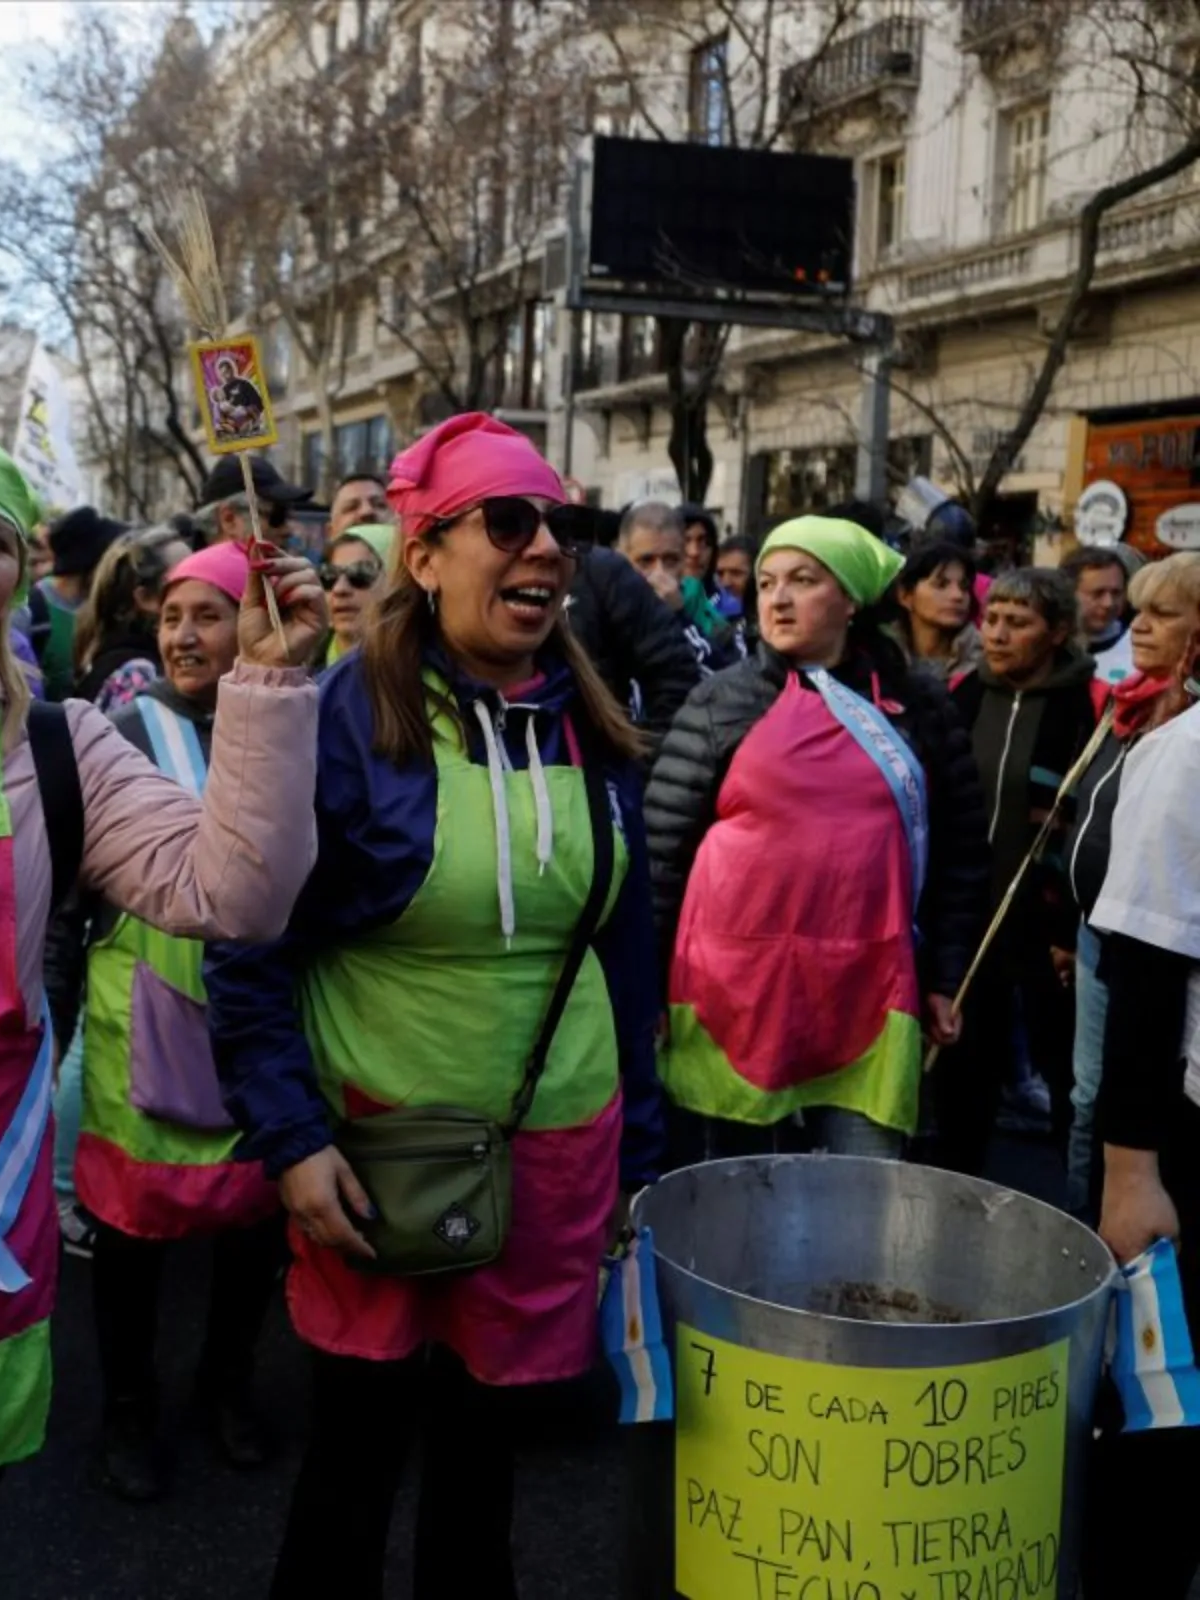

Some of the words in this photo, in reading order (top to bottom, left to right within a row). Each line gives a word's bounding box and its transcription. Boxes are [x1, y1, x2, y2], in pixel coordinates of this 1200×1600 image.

[690, 1341, 717, 1397] 7
[744, 1379, 785, 1414] DE
[807, 1392, 889, 1425] CADA
[914, 1378, 968, 1427] 10
[993, 1370, 1059, 1422] PIBES
[747, 1429, 821, 1486] SON
[883, 1426, 1027, 1488] POBRES
